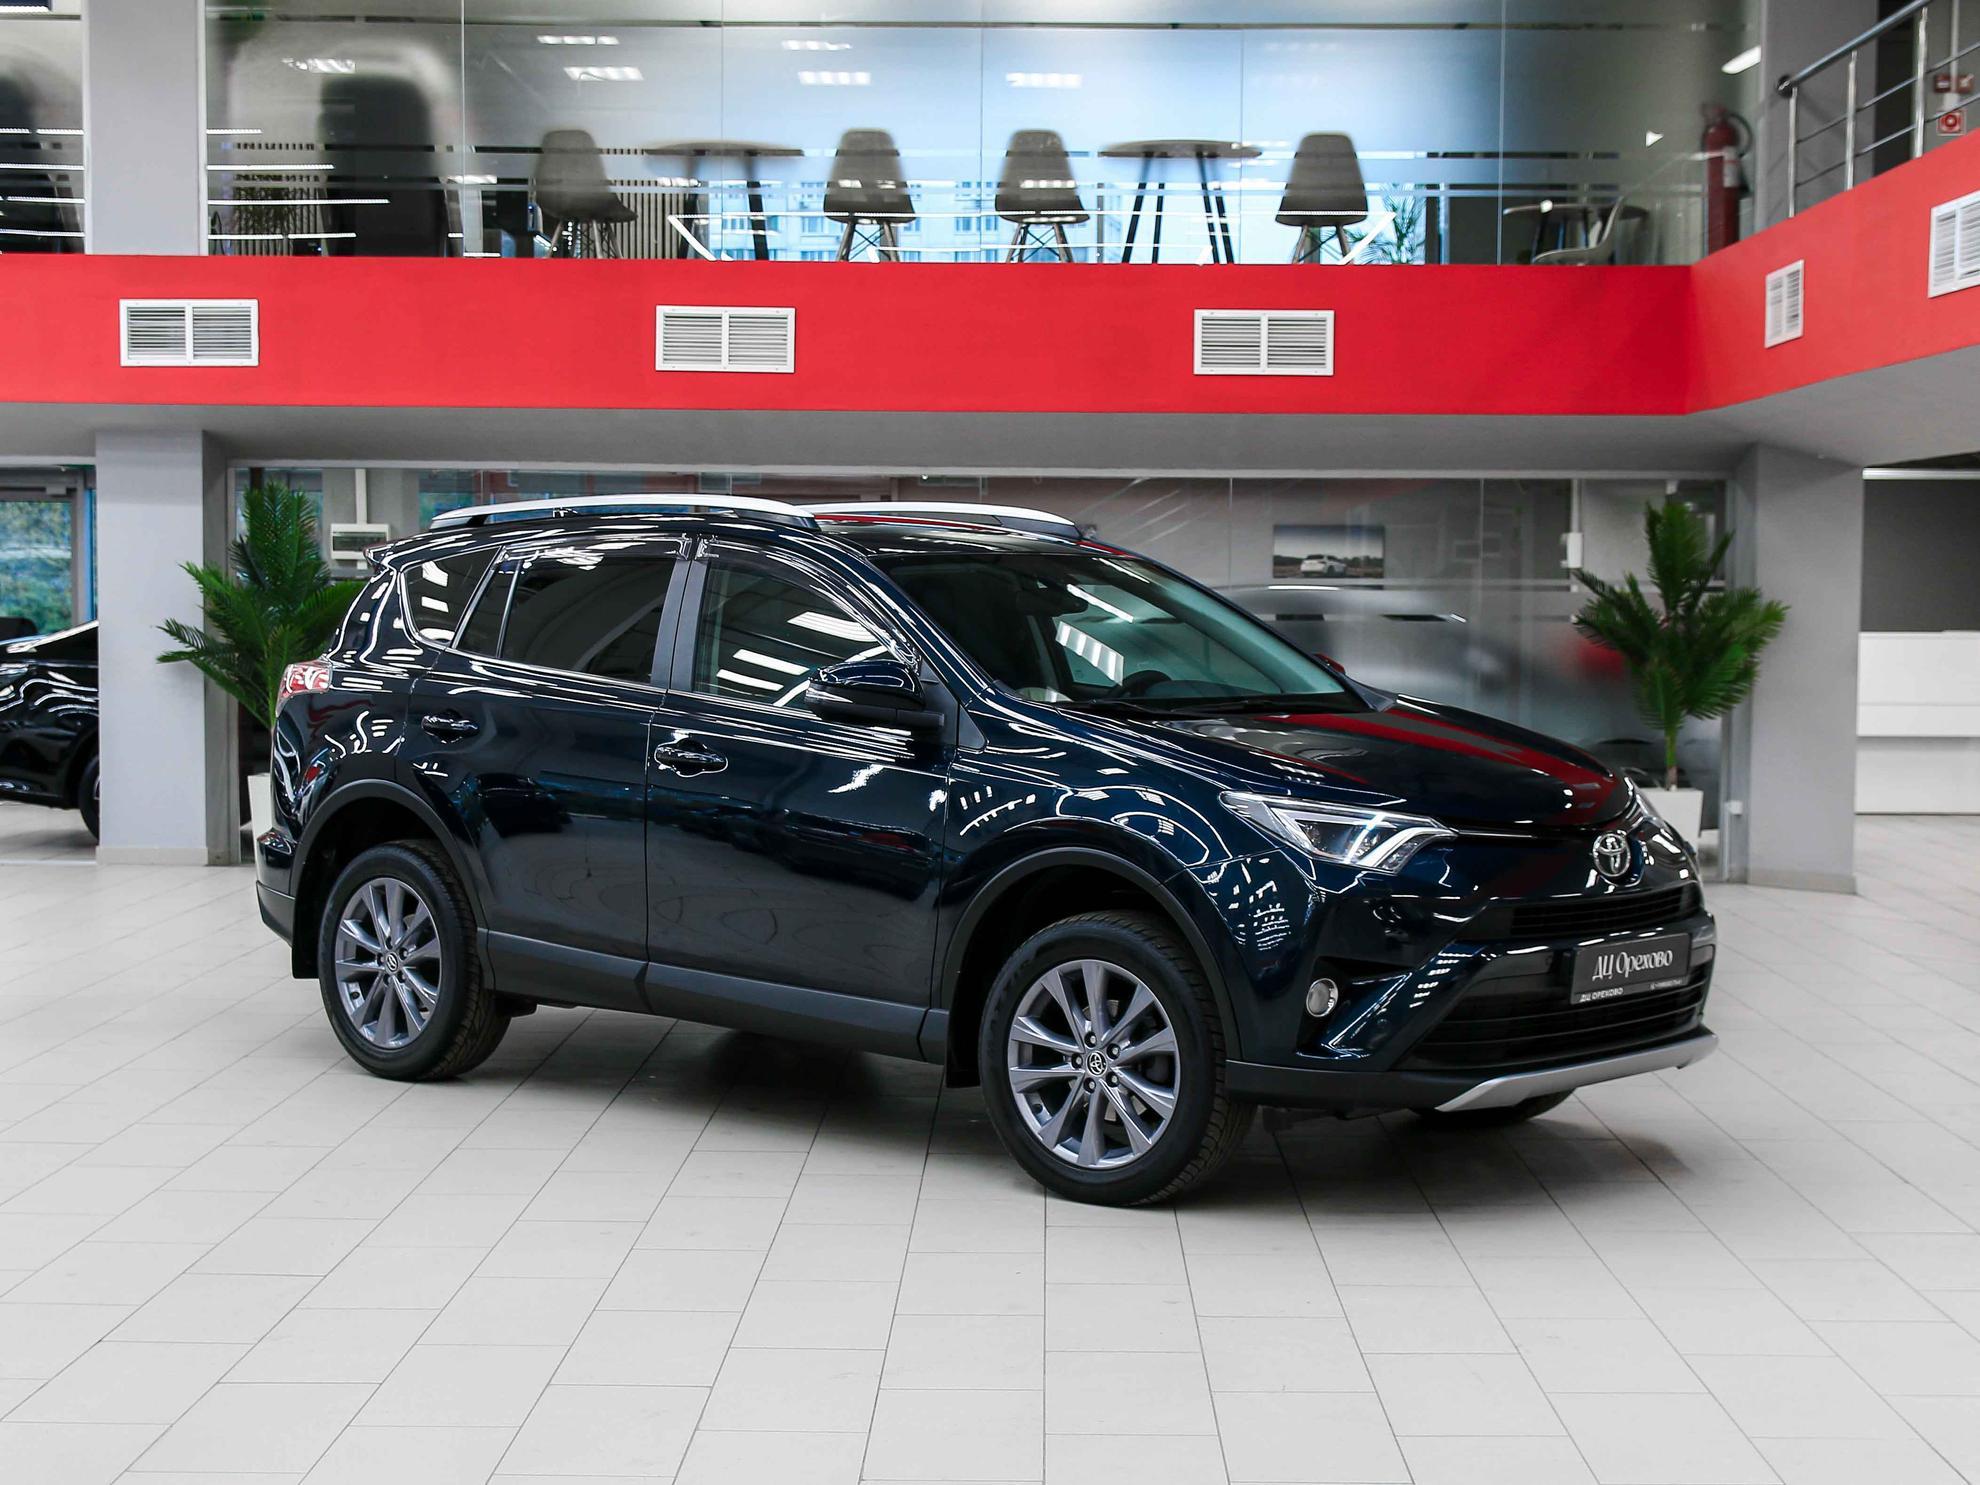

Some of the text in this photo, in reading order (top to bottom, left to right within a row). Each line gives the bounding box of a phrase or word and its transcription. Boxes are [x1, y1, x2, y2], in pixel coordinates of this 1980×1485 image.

[1592, 950, 1673, 981] ДЦ Орехово
[1592, 987, 1624, 1000] ОРЕХОВО
